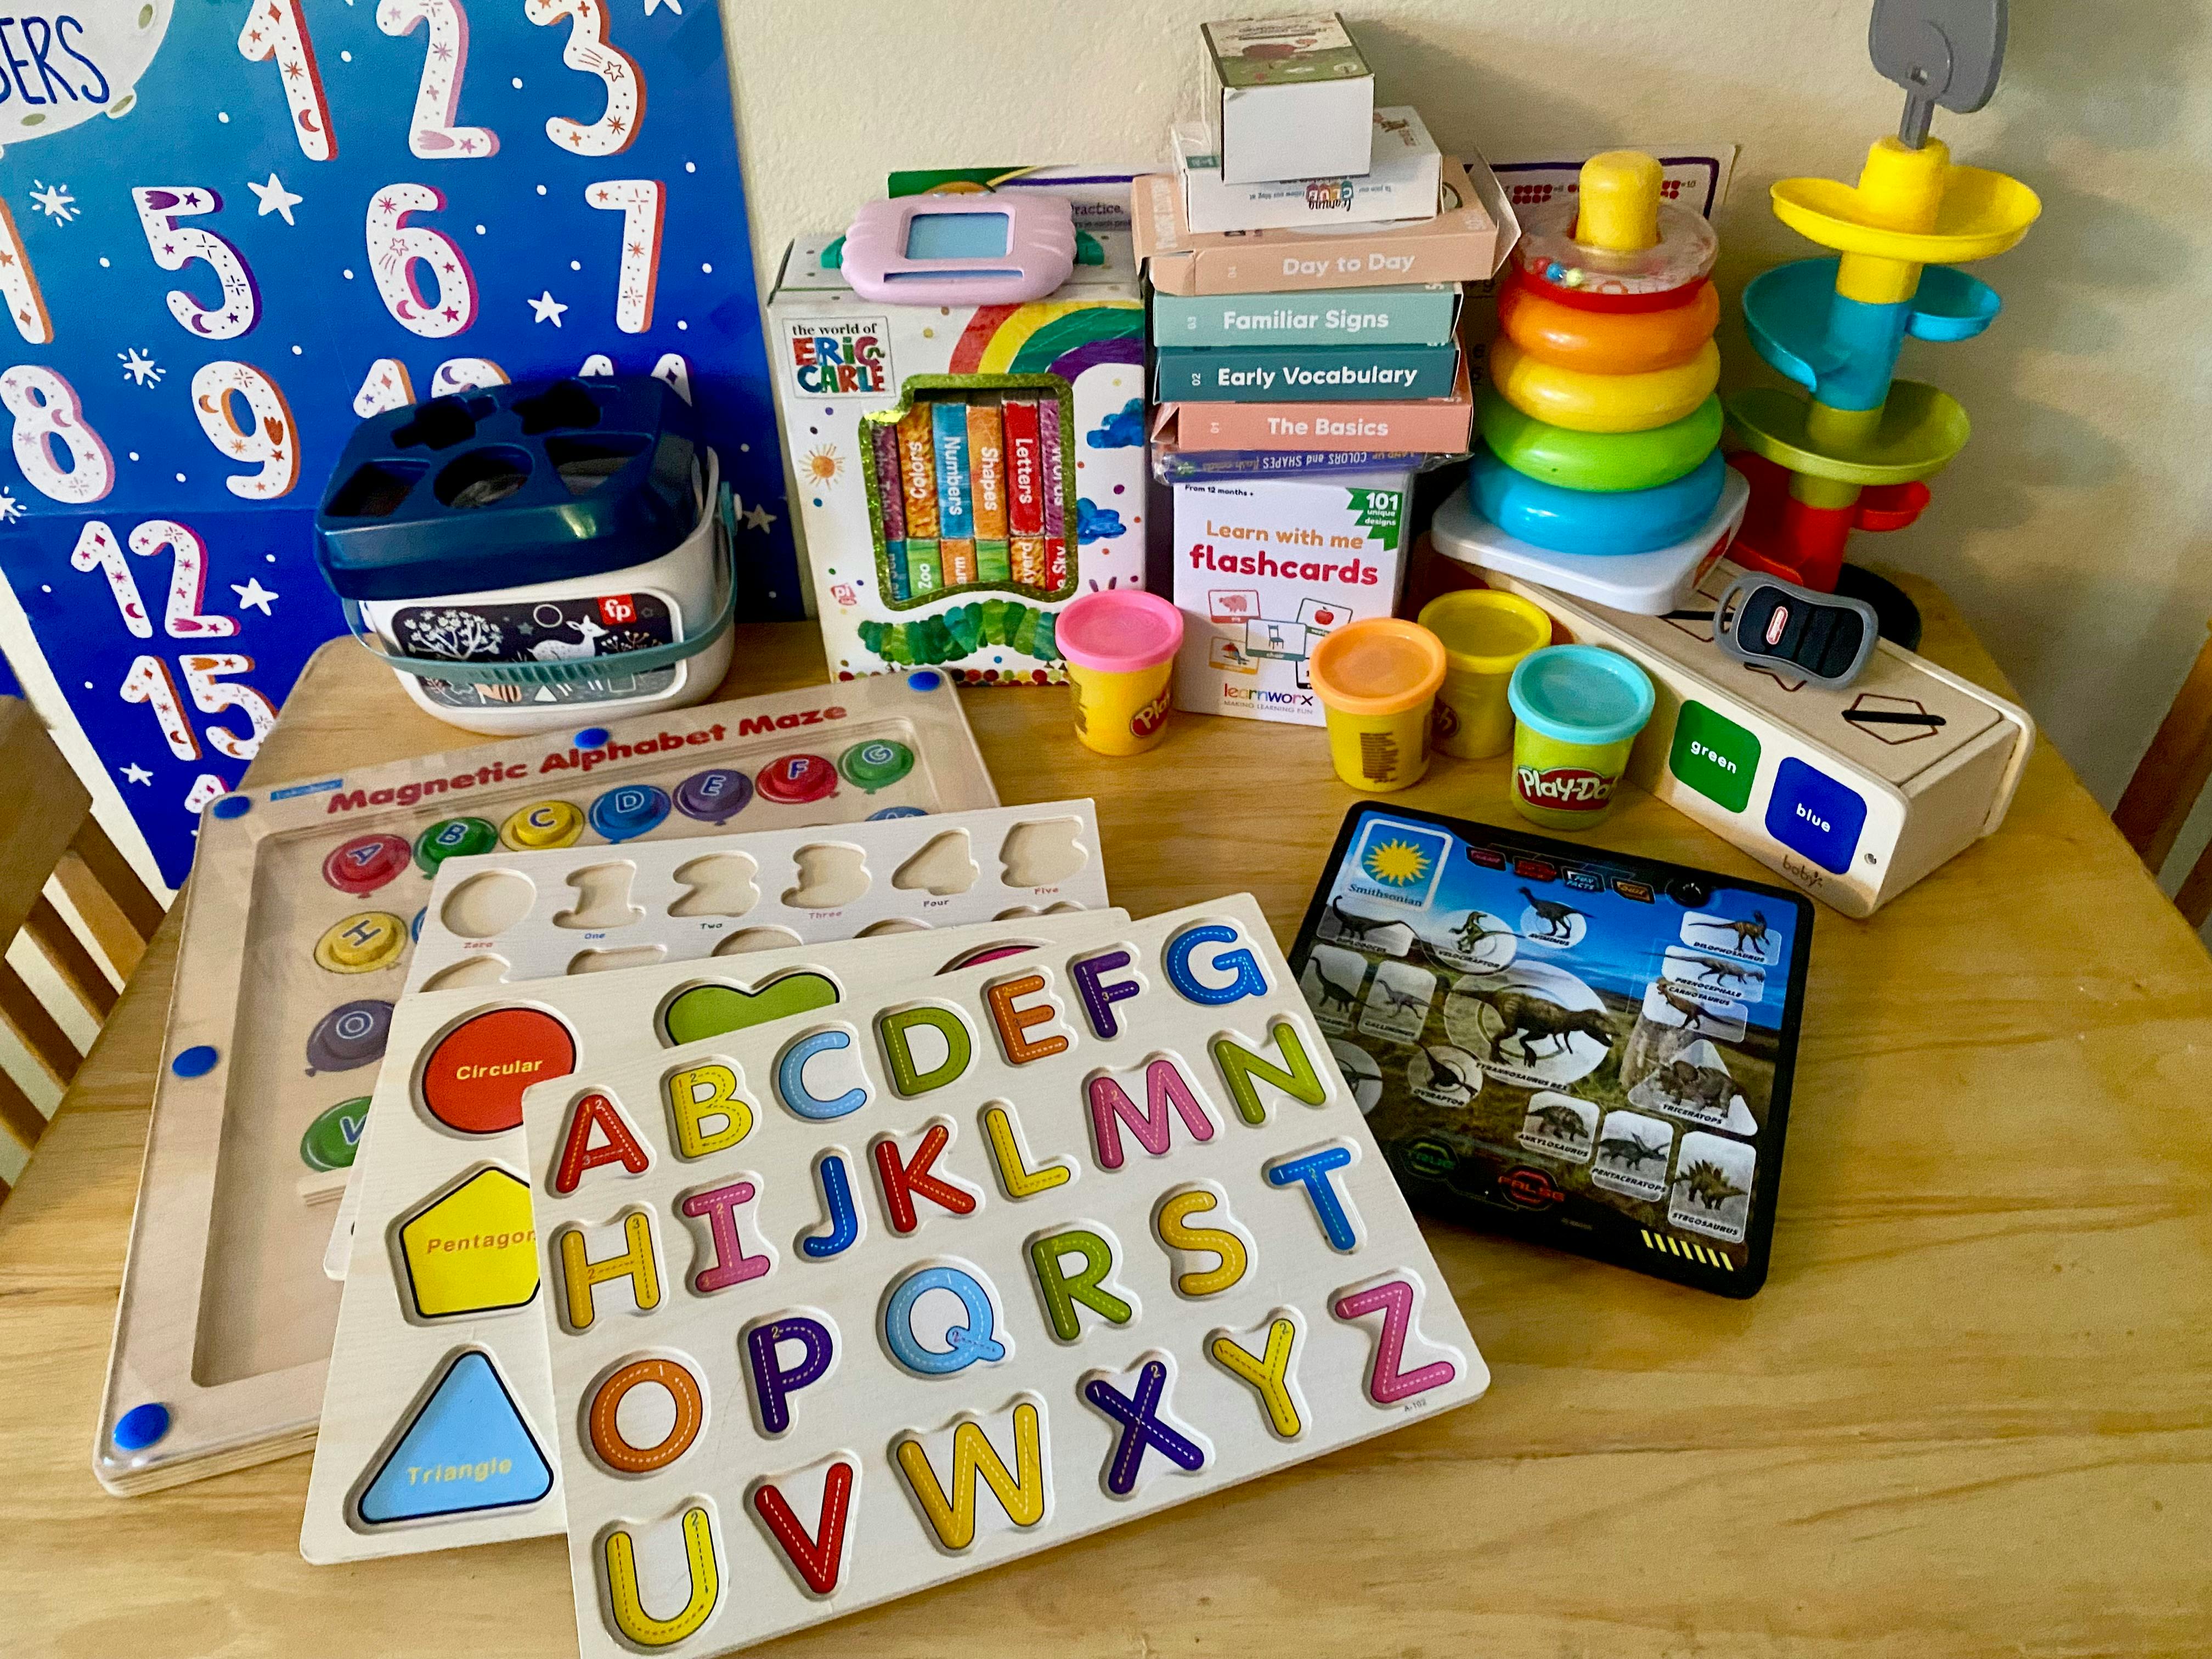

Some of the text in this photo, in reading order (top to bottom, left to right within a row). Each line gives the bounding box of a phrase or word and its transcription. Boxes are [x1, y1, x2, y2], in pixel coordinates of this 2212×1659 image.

[238, 0, 646, 161] 1 2 3
[1307, 182, 1353, 202] CLUB
[132, 187, 262, 340] 5
[366, 183, 478, 338] 6
[585, 180, 666, 333] 7
[1282, 258, 1330, 278] Day
[1336, 256, 1361, 272] to
[1368, 253, 1415, 273] Day
[793, 323, 877, 336] the world of
[1223, 311, 1319, 330] Familiar
[1325, 311, 1389, 332] Signs
[797, 365, 885, 393] CARLE
[1192, 366, 1418, 390] 02 Early Vocabulary
[0, 365, 115, 503] 8
[191, 361, 301, 500] 9
[1268, 418, 1307, 436] The
[1315, 418, 1389, 437] Basics
[909, 441, 928, 500] Colors
[1015, 438, 1034, 505] Letters
[1262, 455, 1302, 469] SHAPES
[1306, 455, 1323, 466] and
[1328, 453, 1367, 465] COLORS
[944, 436, 963, 516] Numbers
[980, 446, 1001, 512] Shapes
[1184, 484, 1205, 493] From
[1217, 488, 1248, 496] months
[1365, 492, 1398, 510] 101
[1367, 509, 1396, 517] unique
[1206, 520, 1364, 550] Learn with me
[1364, 517, 1396, 527] designs
[918, 563, 933, 590] Zoo
[955, 556, 968, 585] arm
[1020, 541, 1037, 584] kyard
[1189, 543, 1378, 586] flashcards
[70, 520, 241, 639] 12
[605, 598, 632, 624] fp
[120, 655, 279, 760] 15
[1224, 683, 1314, 707] learnworx
[1224, 700, 1254, 709] MAKING
[1257, 704, 1295, 713] LEARNING
[326, 760, 528, 815] Magnetic
[539, 724, 727, 775] Alphabet
[739, 703, 848, 737] Maze
[1690, 738, 1738, 775] green
[1519, 768, 1612, 802] Play-Do
[346, 744, 894, 867] A B C D E F G
[1795, 803, 1832, 834] blue
[1347, 883, 1423, 907] Smithsonian
[464, 885, 1060, 950] Zero One Two Three Four Five
[342, 919, 381, 947] H
[336, 1011, 374, 1040] O
[456, 1058, 544, 1081] Circular
[556, 925, 1268, 1194] A B C D E F G
[1662, 1103, 1723, 1125] TRICERATOPS
[1517, 1133, 1589, 1158] ANKYLOSAURUS
[561, 1023, 1327, 1328] H I J K L M N
[1592, 1167, 1668, 1193] PENTACERATOPS
[1672, 1212, 1739, 1237] STEGOSAURUS
[590, 1147, 1351, 1473] O P Q R S T
[407, 1458, 513, 1487] Triangle
[605, 1280, 1455, 1646] U V W X Y Z
